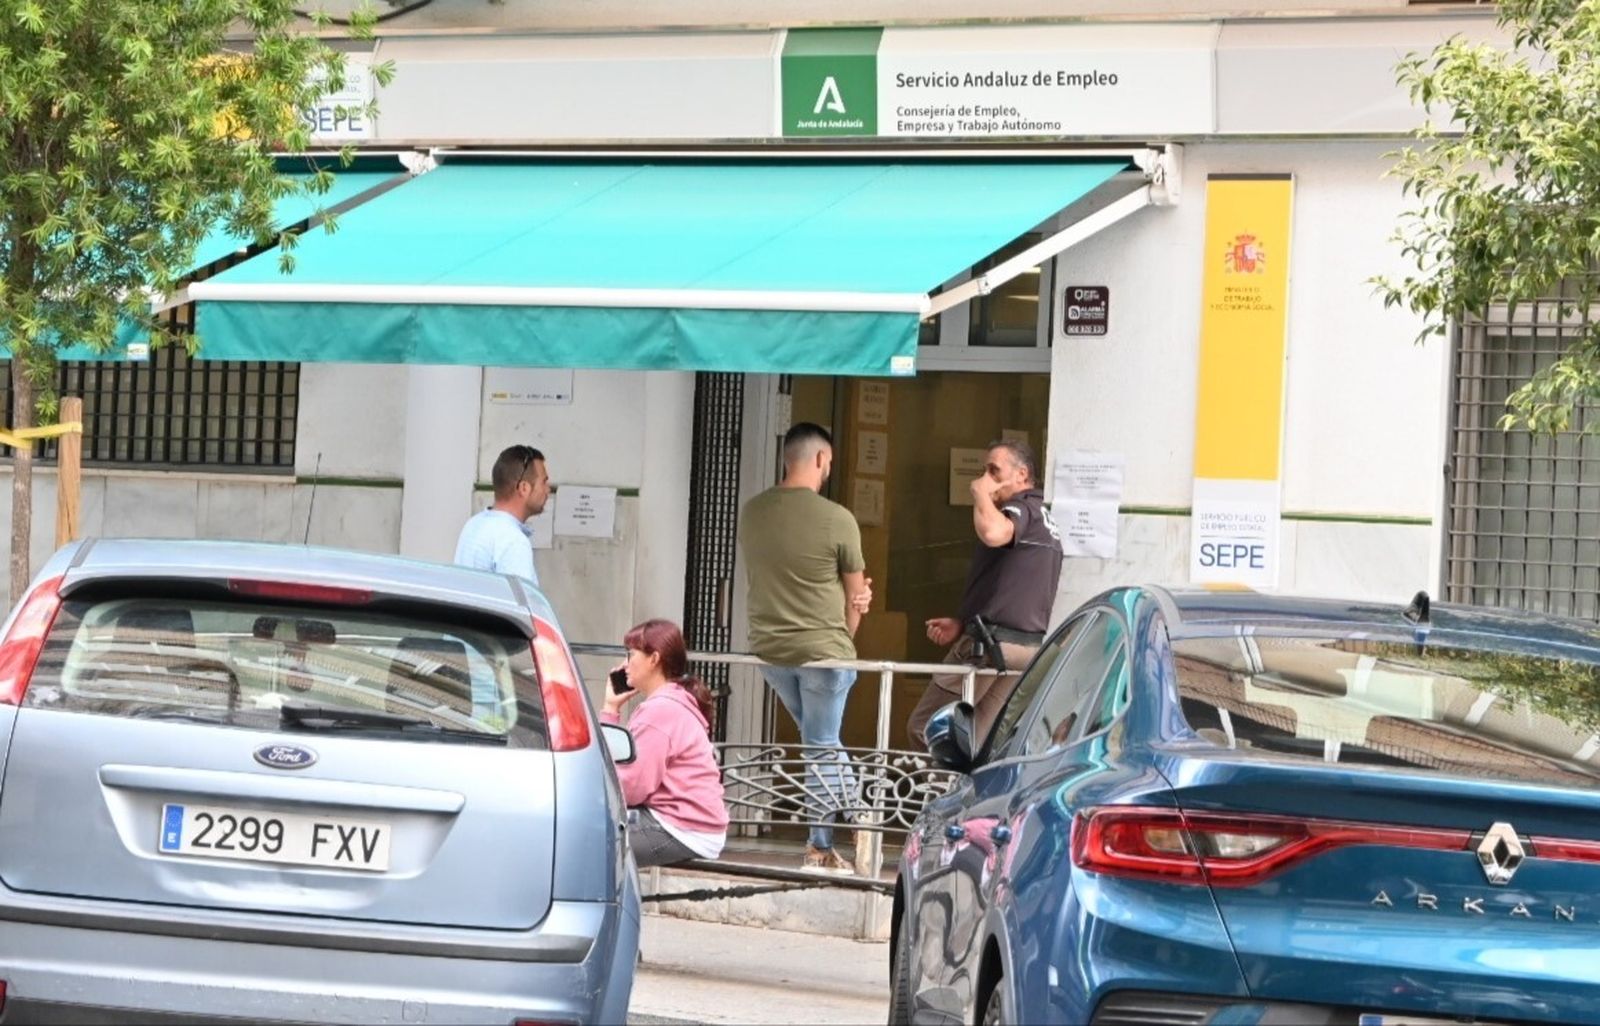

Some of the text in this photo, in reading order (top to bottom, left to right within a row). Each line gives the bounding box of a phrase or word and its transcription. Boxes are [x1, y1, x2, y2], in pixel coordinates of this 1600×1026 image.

[896, 70, 1119, 90] Servicio Andaluz de Empleo
[302, 106, 364, 134] SEPE
[896, 104, 1021, 119] Consejería de Empleo,
[797, 119, 864, 129] Junta de Andalucía
[896, 118, 1062, 134] Empresa y Trabajo Autónomo
[1199, 542, 1265, 568] SEPE
[268, 747, 302, 763] Ford
[167, 833, 177, 843] E
[191, 812, 380, 863] 2299 FXV
[1371, 890, 1600, 925] ARKAN
